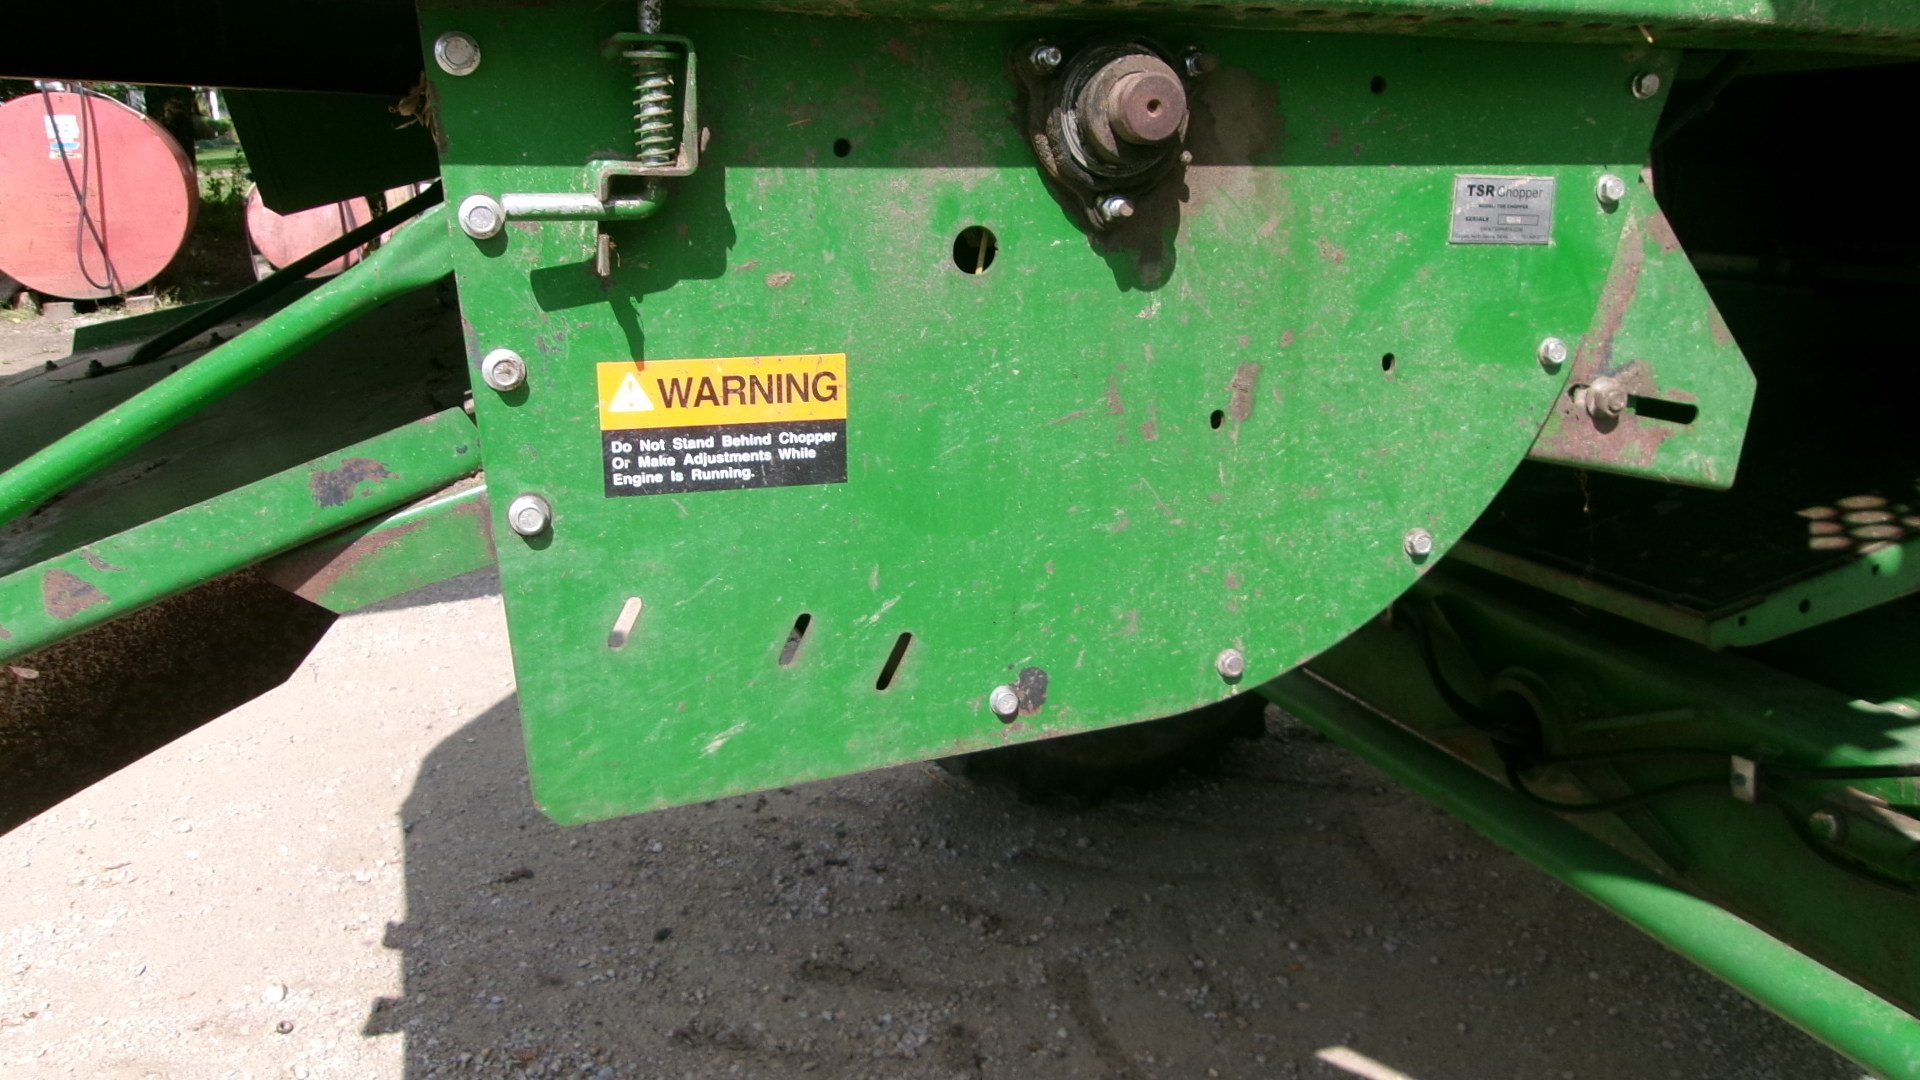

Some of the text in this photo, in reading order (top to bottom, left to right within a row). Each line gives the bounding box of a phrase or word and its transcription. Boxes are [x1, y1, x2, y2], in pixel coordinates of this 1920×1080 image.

[1467, 184, 1543, 200] TSR Chopper
[656, 371, 838, 409] WARNING
[611, 431, 837, 454] Do Not Stand Behind Chopper
[612, 446, 817, 469] Or Make Adjustments While
[613, 466, 755, 487] Engine Is Running.
